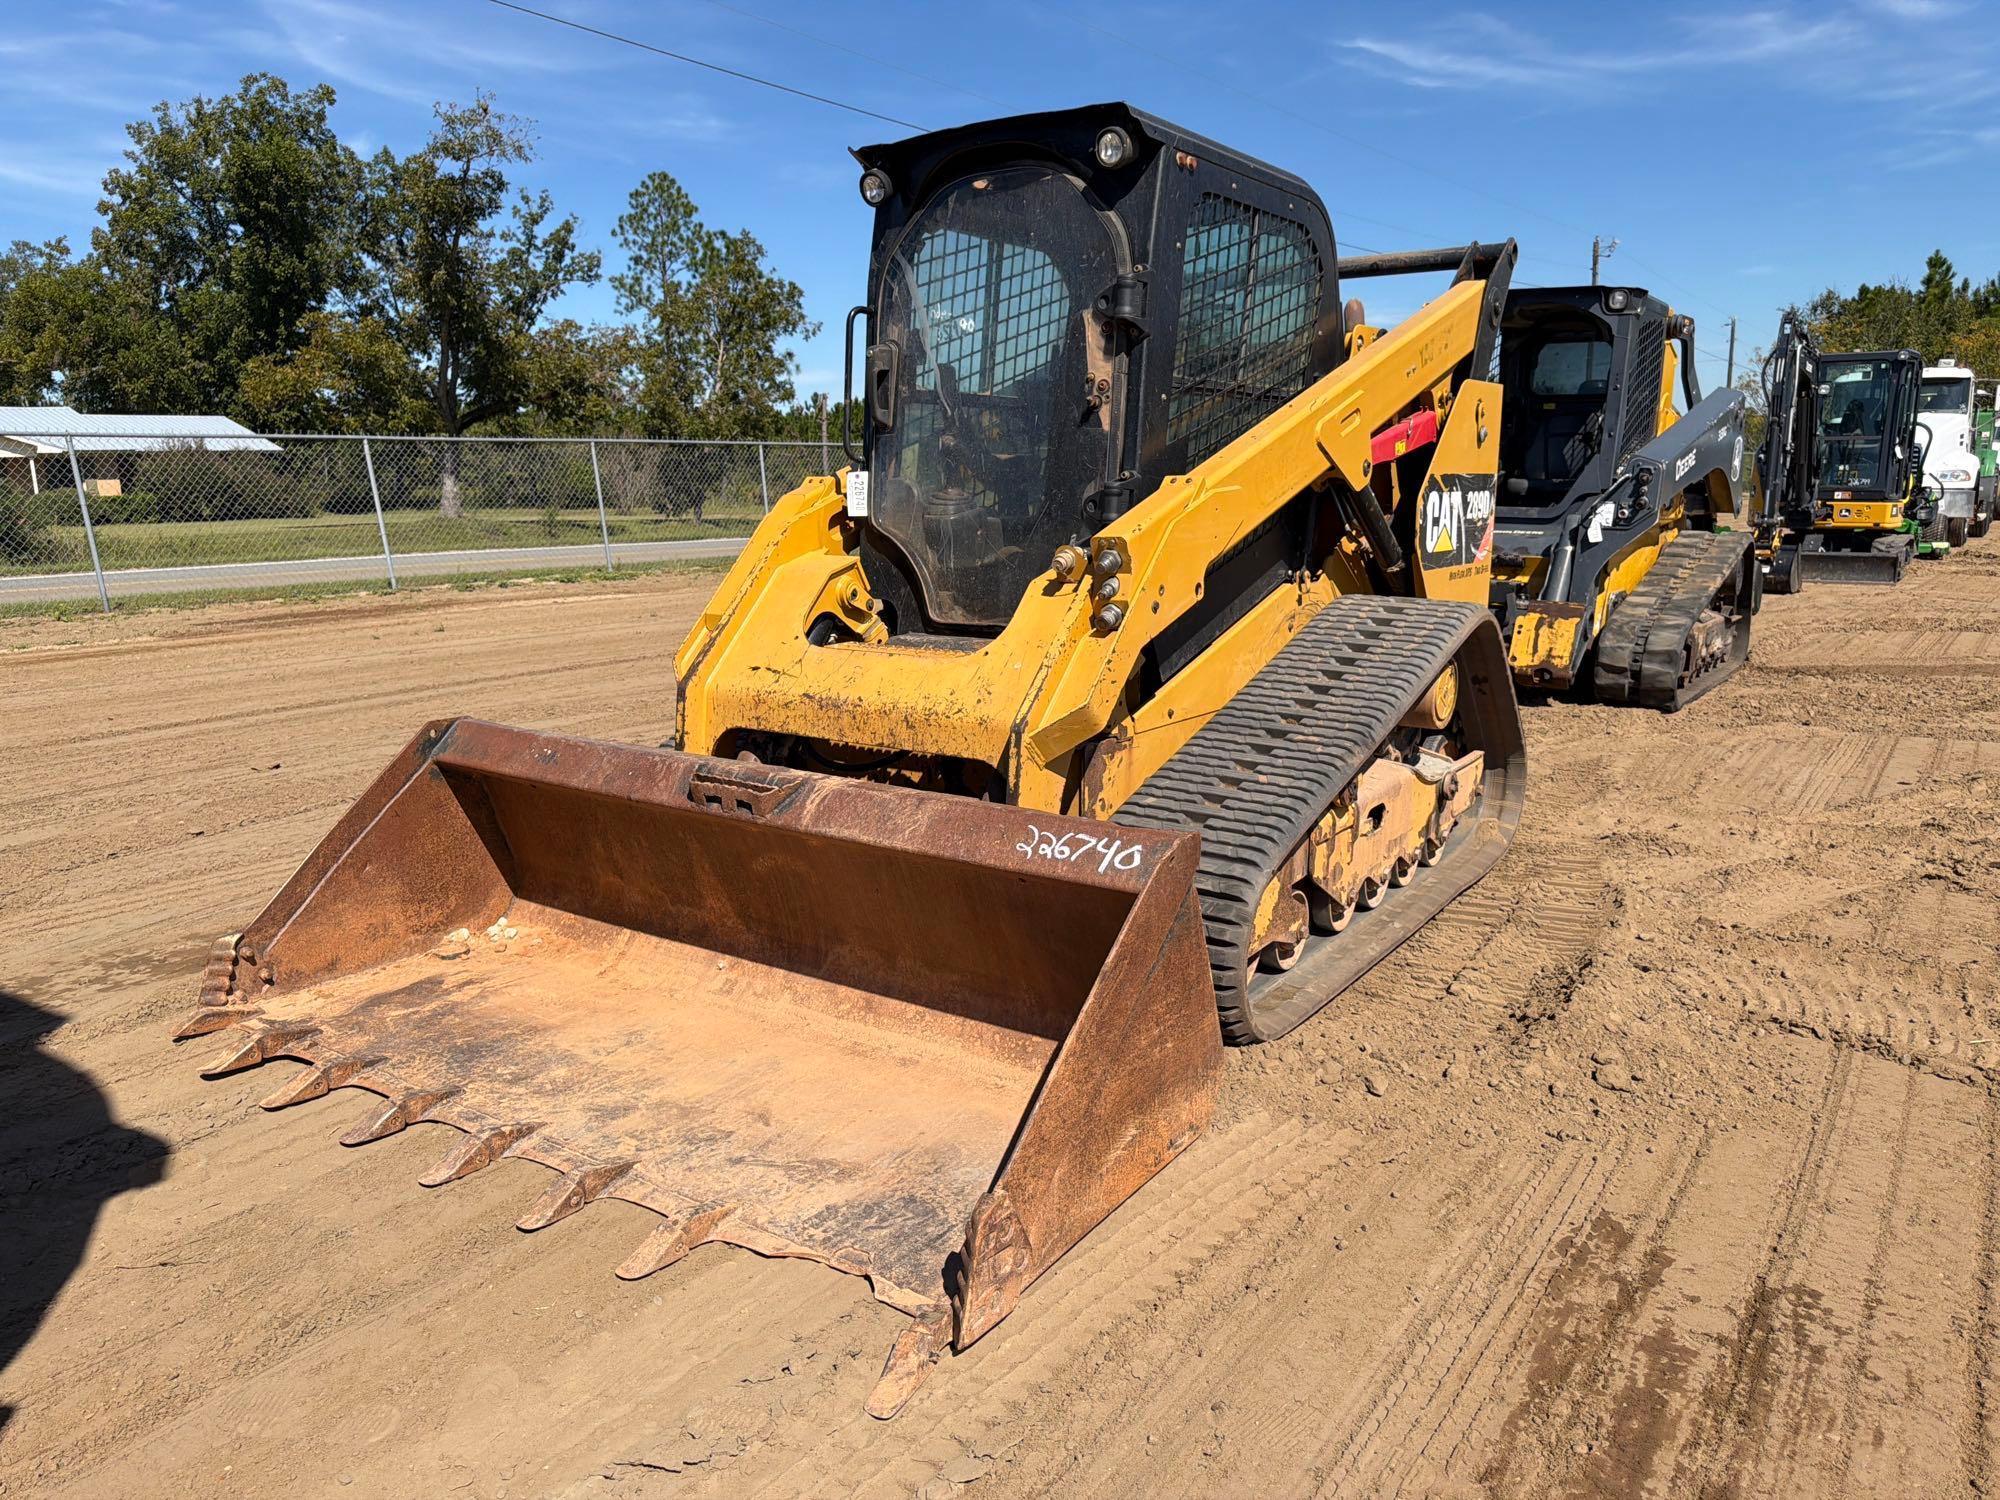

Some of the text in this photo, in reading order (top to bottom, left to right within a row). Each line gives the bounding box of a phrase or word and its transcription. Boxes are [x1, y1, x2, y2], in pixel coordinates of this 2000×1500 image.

[1675, 448, 1697, 481] DEERE
[854, 481, 865, 511] 226740
[1425, 490, 1491, 553] CAT 289D
[1016, 825, 1143, 875] 226740
